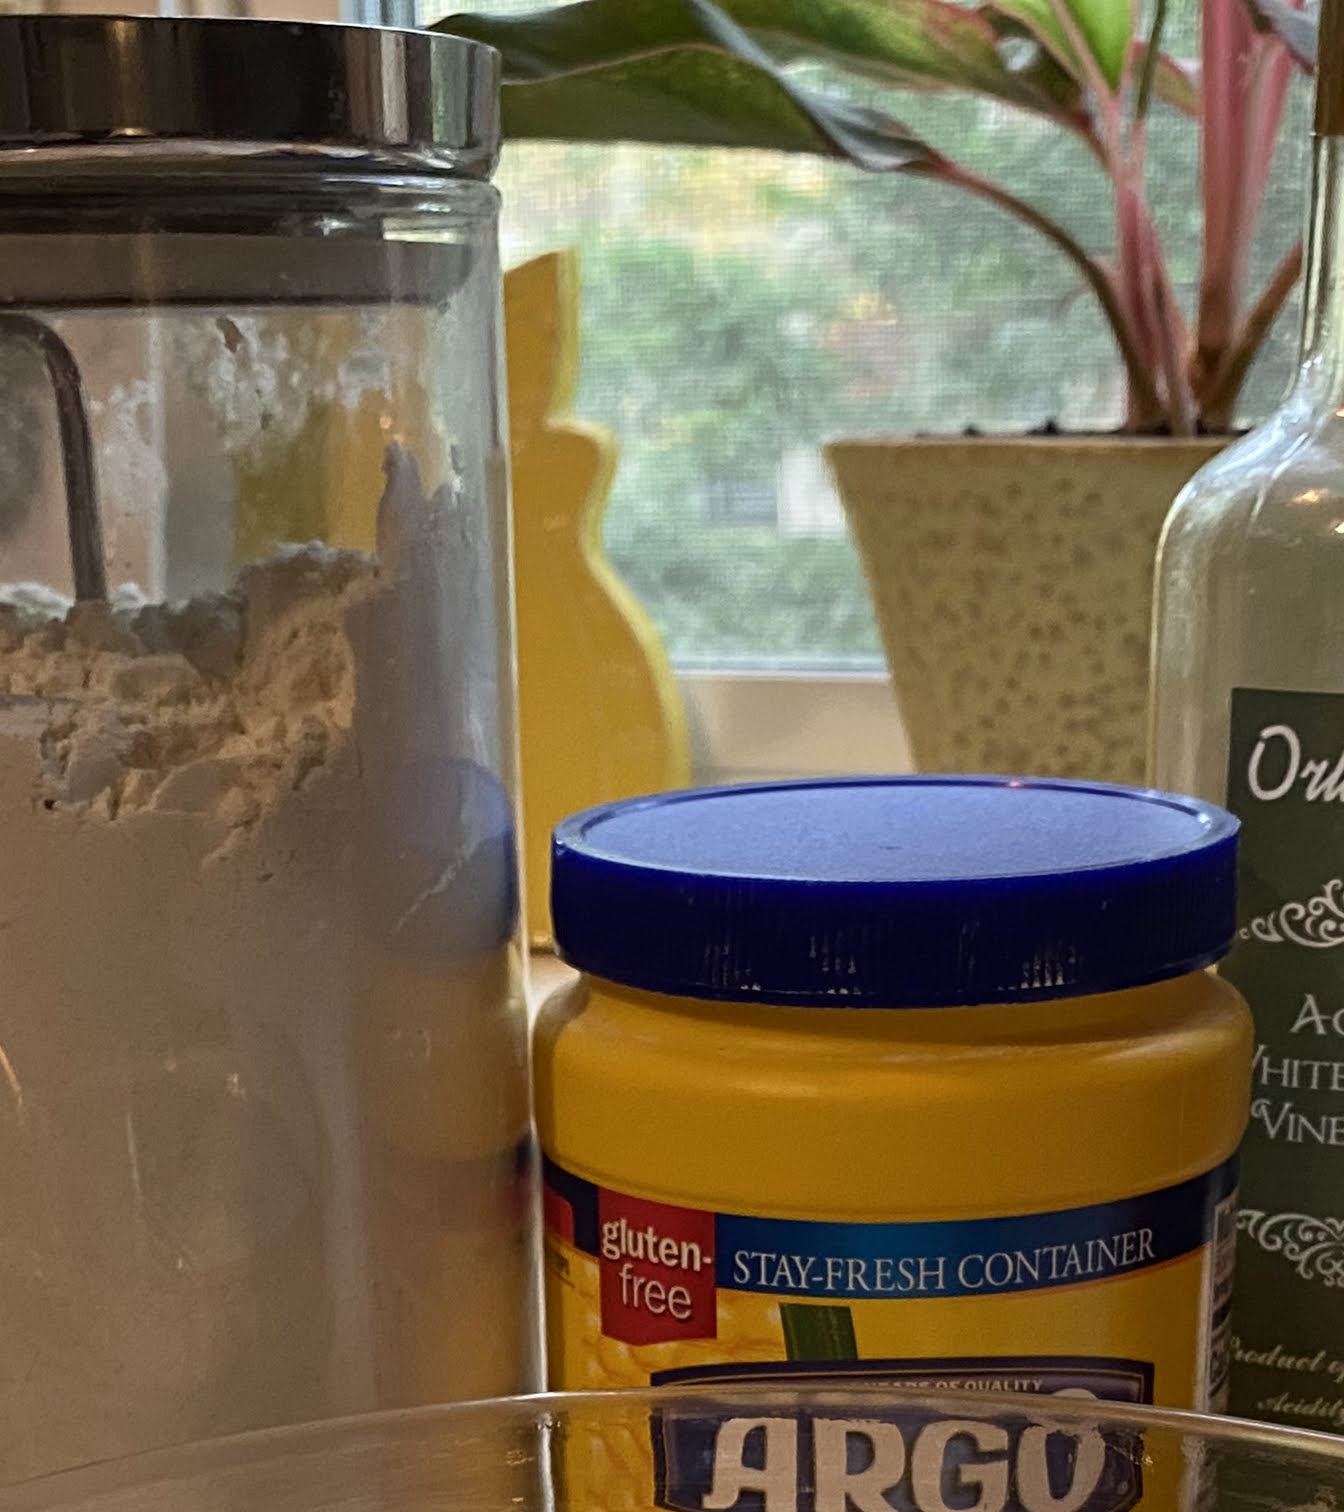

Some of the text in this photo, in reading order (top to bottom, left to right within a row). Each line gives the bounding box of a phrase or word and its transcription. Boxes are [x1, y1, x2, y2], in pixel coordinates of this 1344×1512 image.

[601, 1217, 713, 1273] gluten-
[732, 1227, 1156, 1293] STAY-FRESH CONTAINER
[618, 1263, 693, 1320] free
